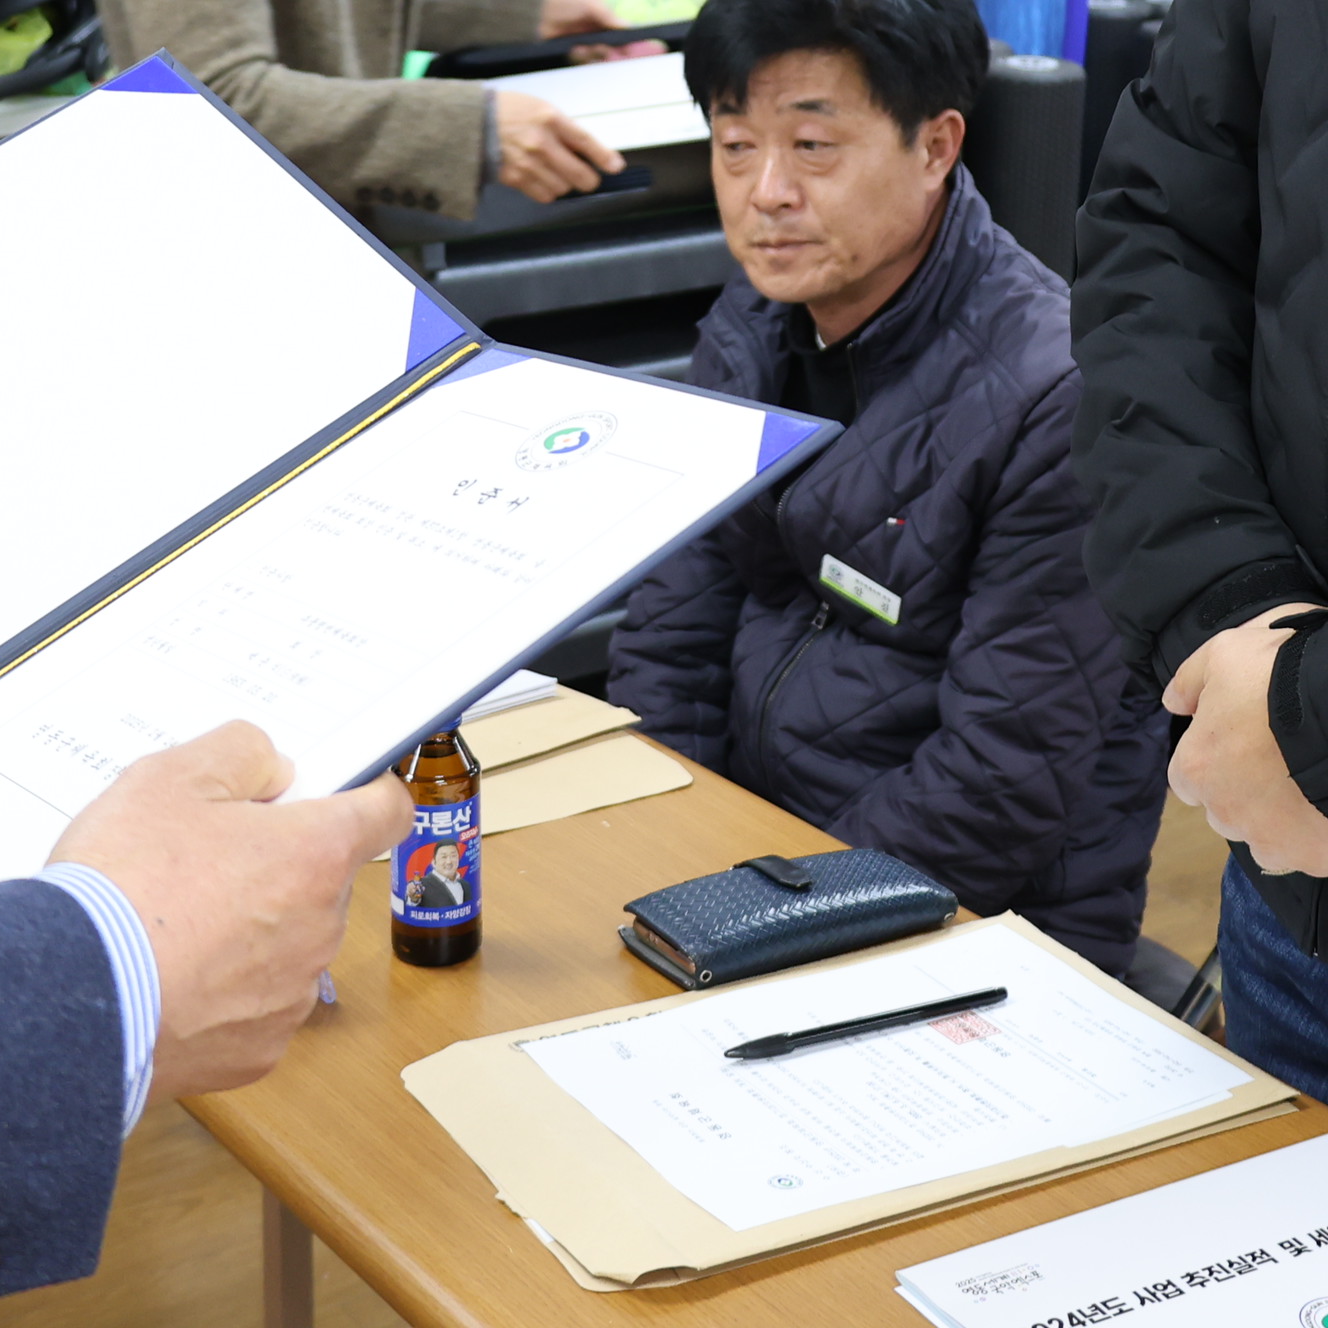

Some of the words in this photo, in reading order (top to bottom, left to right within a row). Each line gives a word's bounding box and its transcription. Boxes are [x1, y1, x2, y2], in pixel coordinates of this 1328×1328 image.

[412, 805, 471, 836] 구론산
[1132, 1278, 1186, 1307] 사업
[1180, 1248, 1280, 1289] 추진실적
[1278, 1237, 1313, 1258] 및
